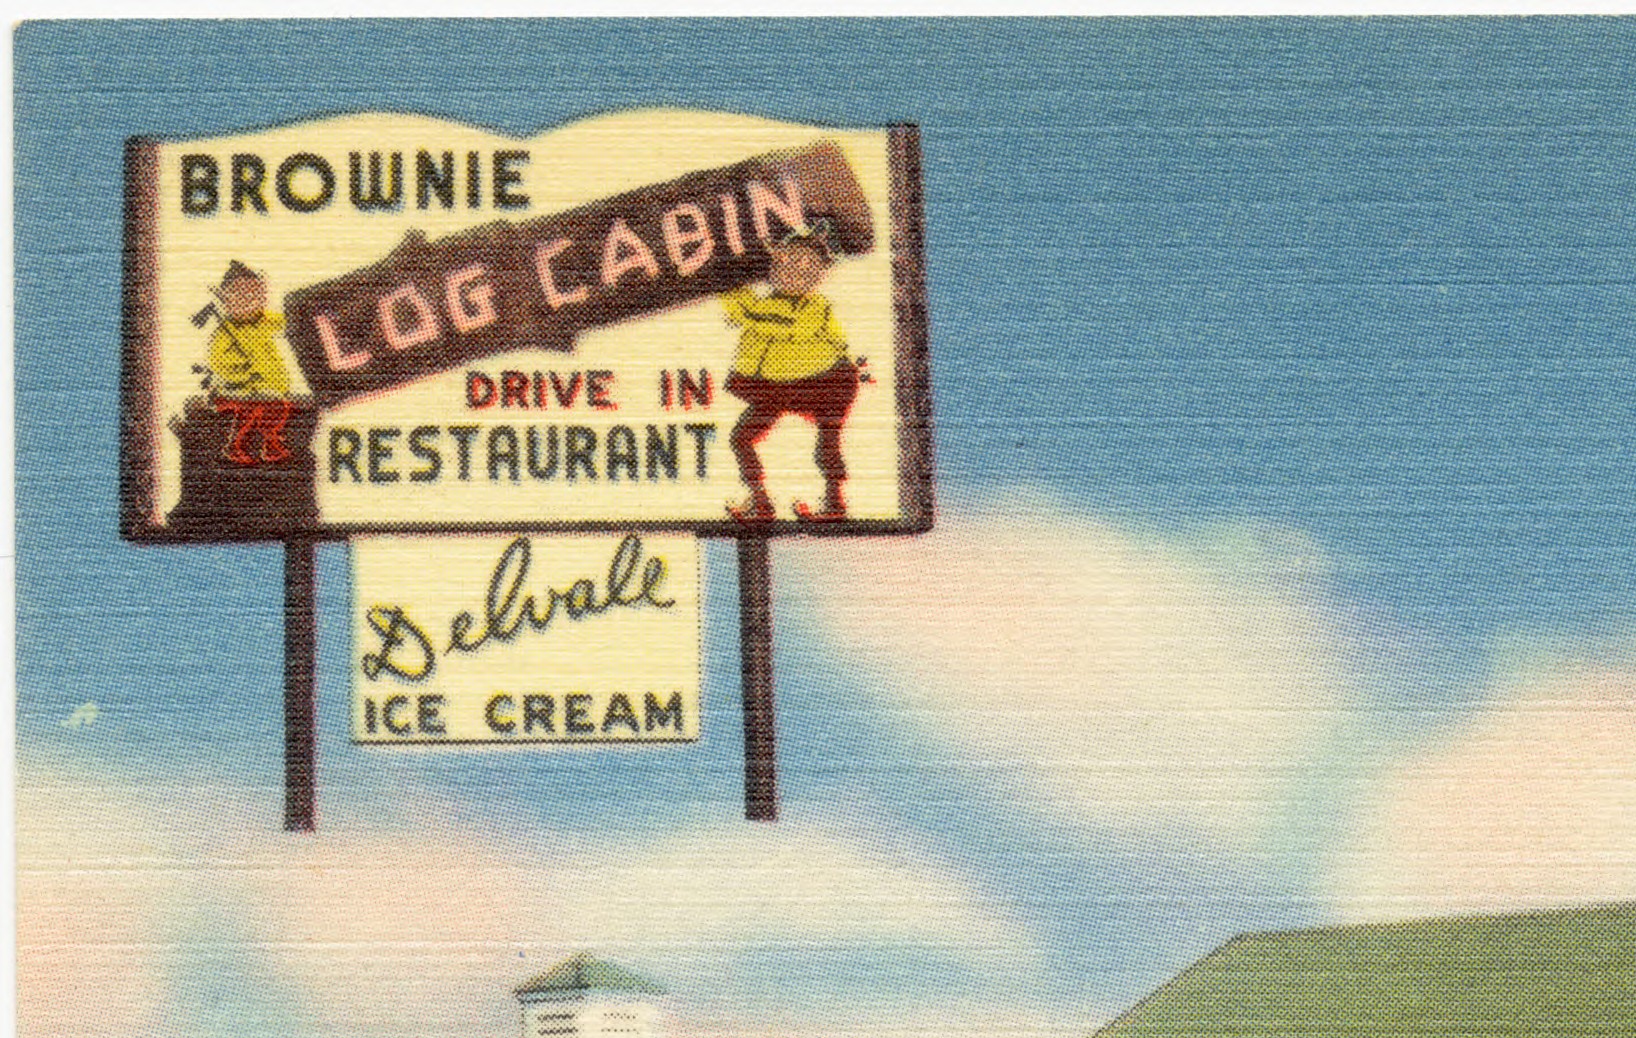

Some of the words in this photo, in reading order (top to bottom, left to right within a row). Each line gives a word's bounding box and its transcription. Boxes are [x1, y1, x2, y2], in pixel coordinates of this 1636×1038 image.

[179, 150, 531, 216] BROWNIE
[314, 263, 498, 372] LOG
[537, 179, 807, 312] CABIN
[466, 370, 617, 410] DRIVE
[660, 368, 713, 409] IN
[328, 423, 717, 485] RESTAURANT
[362, 534, 676, 681] Delvale
[364, 693, 446, 735] ICE
[485, 692, 683, 734] CREAM
